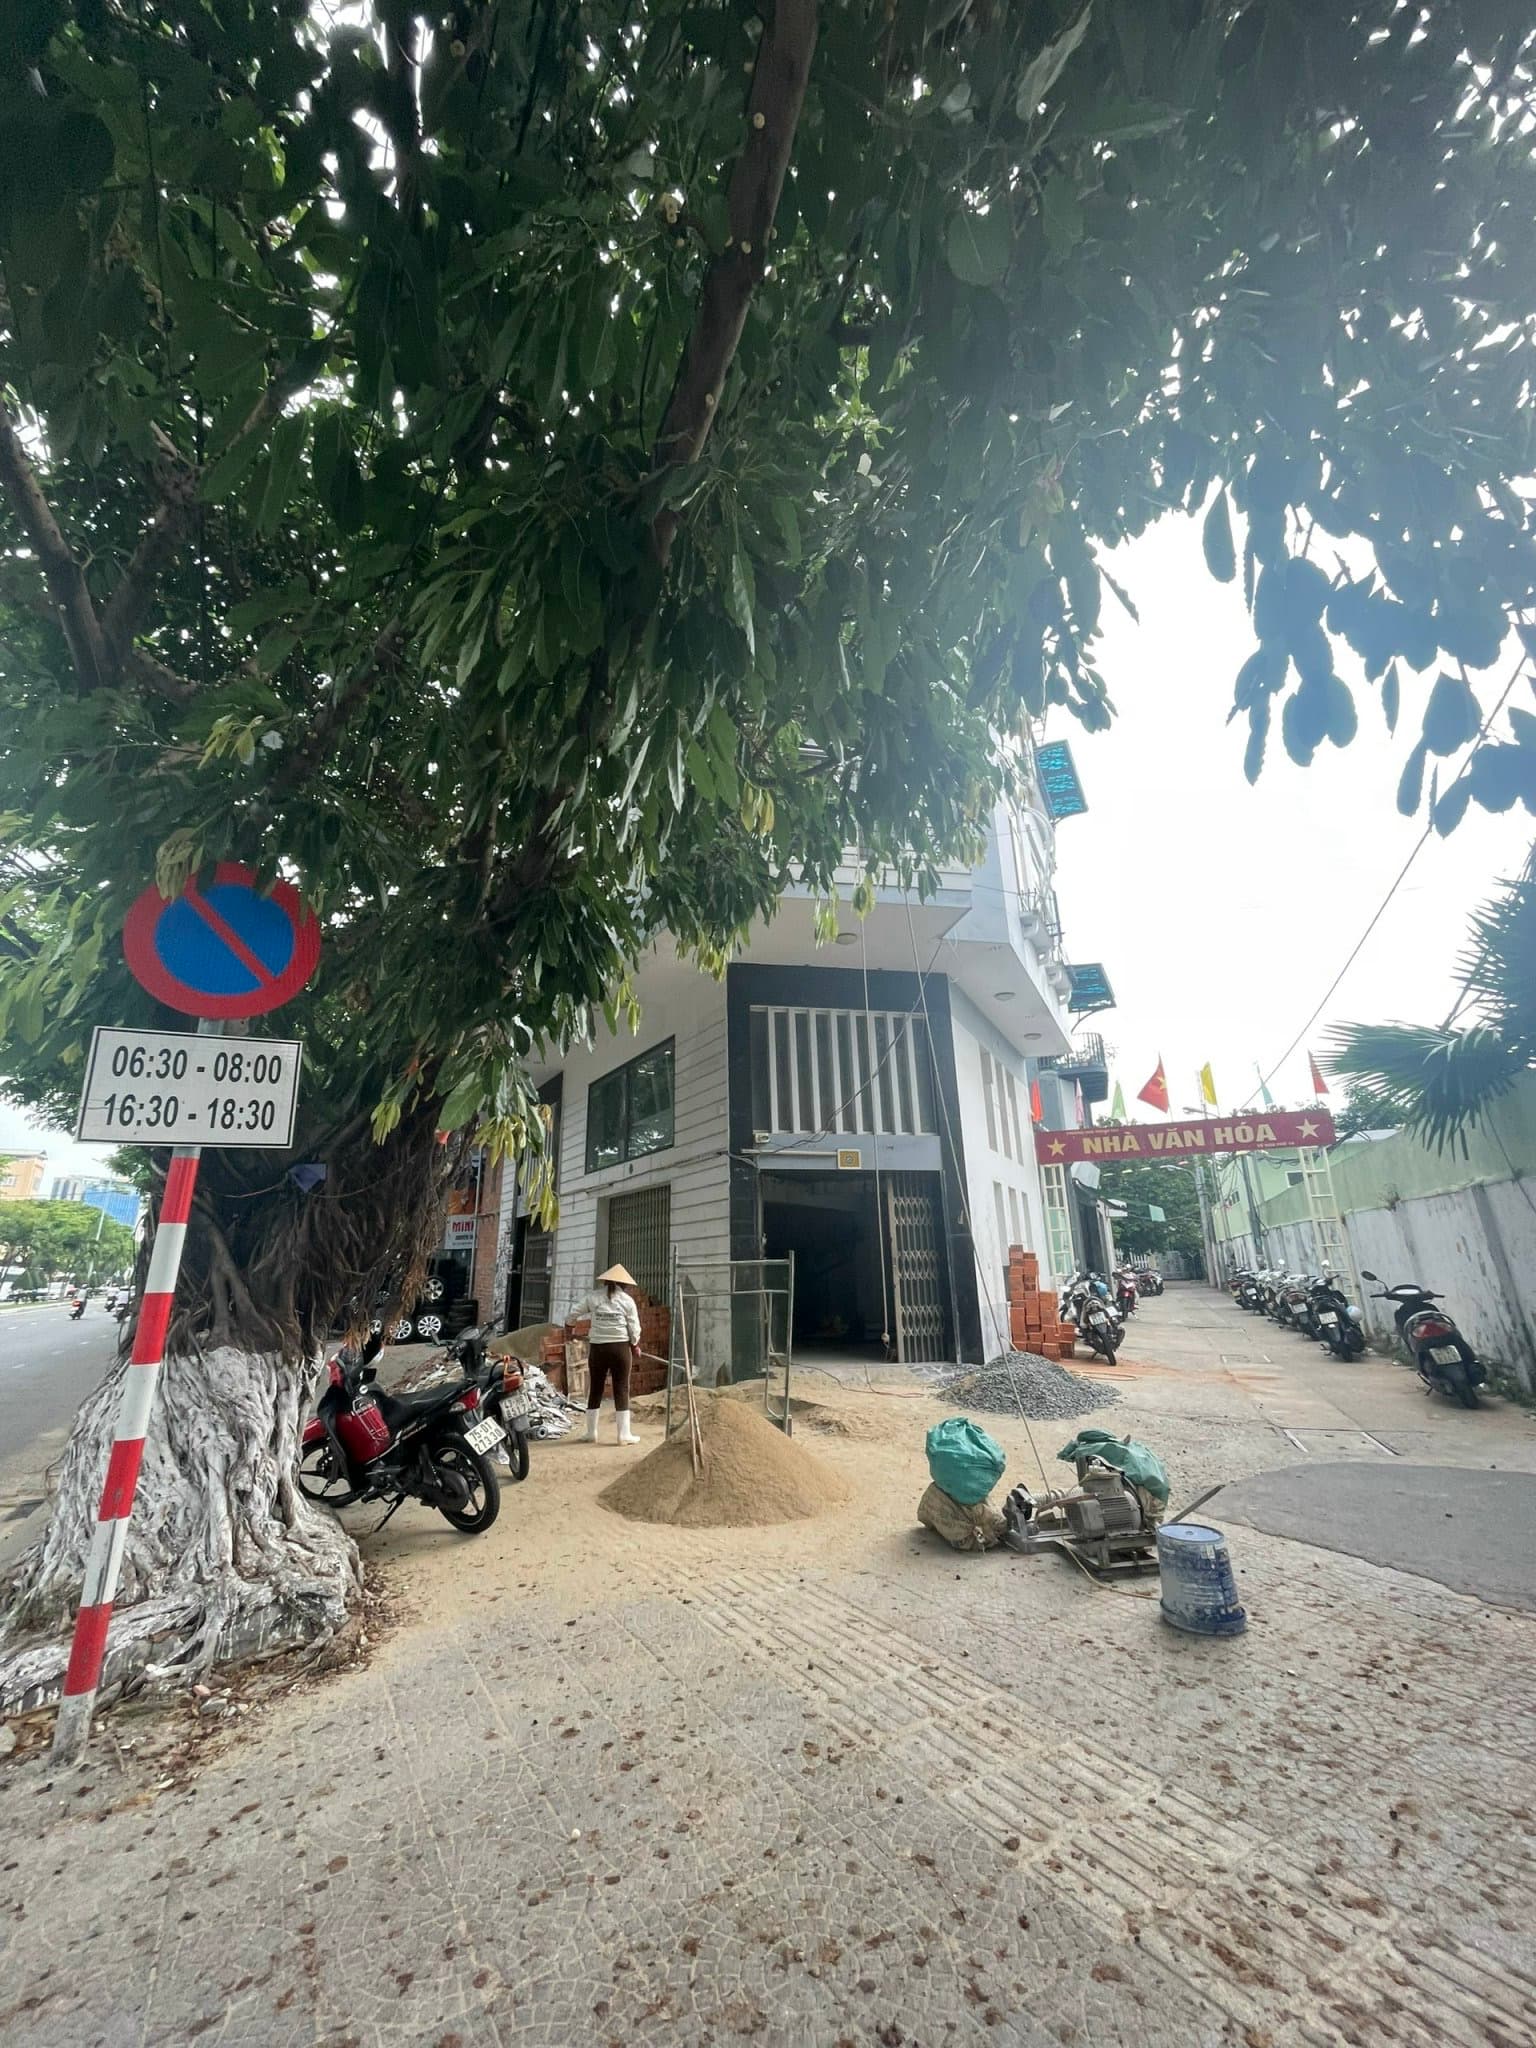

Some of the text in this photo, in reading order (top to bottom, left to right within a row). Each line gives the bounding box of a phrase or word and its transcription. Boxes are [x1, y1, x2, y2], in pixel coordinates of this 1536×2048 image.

[112, 1045, 188, 1080] 06:30
[213, 1052, 282, 1084] 08:00
[104, 1093, 275, 1131] 16:30 - 18:30
[1082, 1121, 1277, 1154] NHÀ VĂN HÓA
